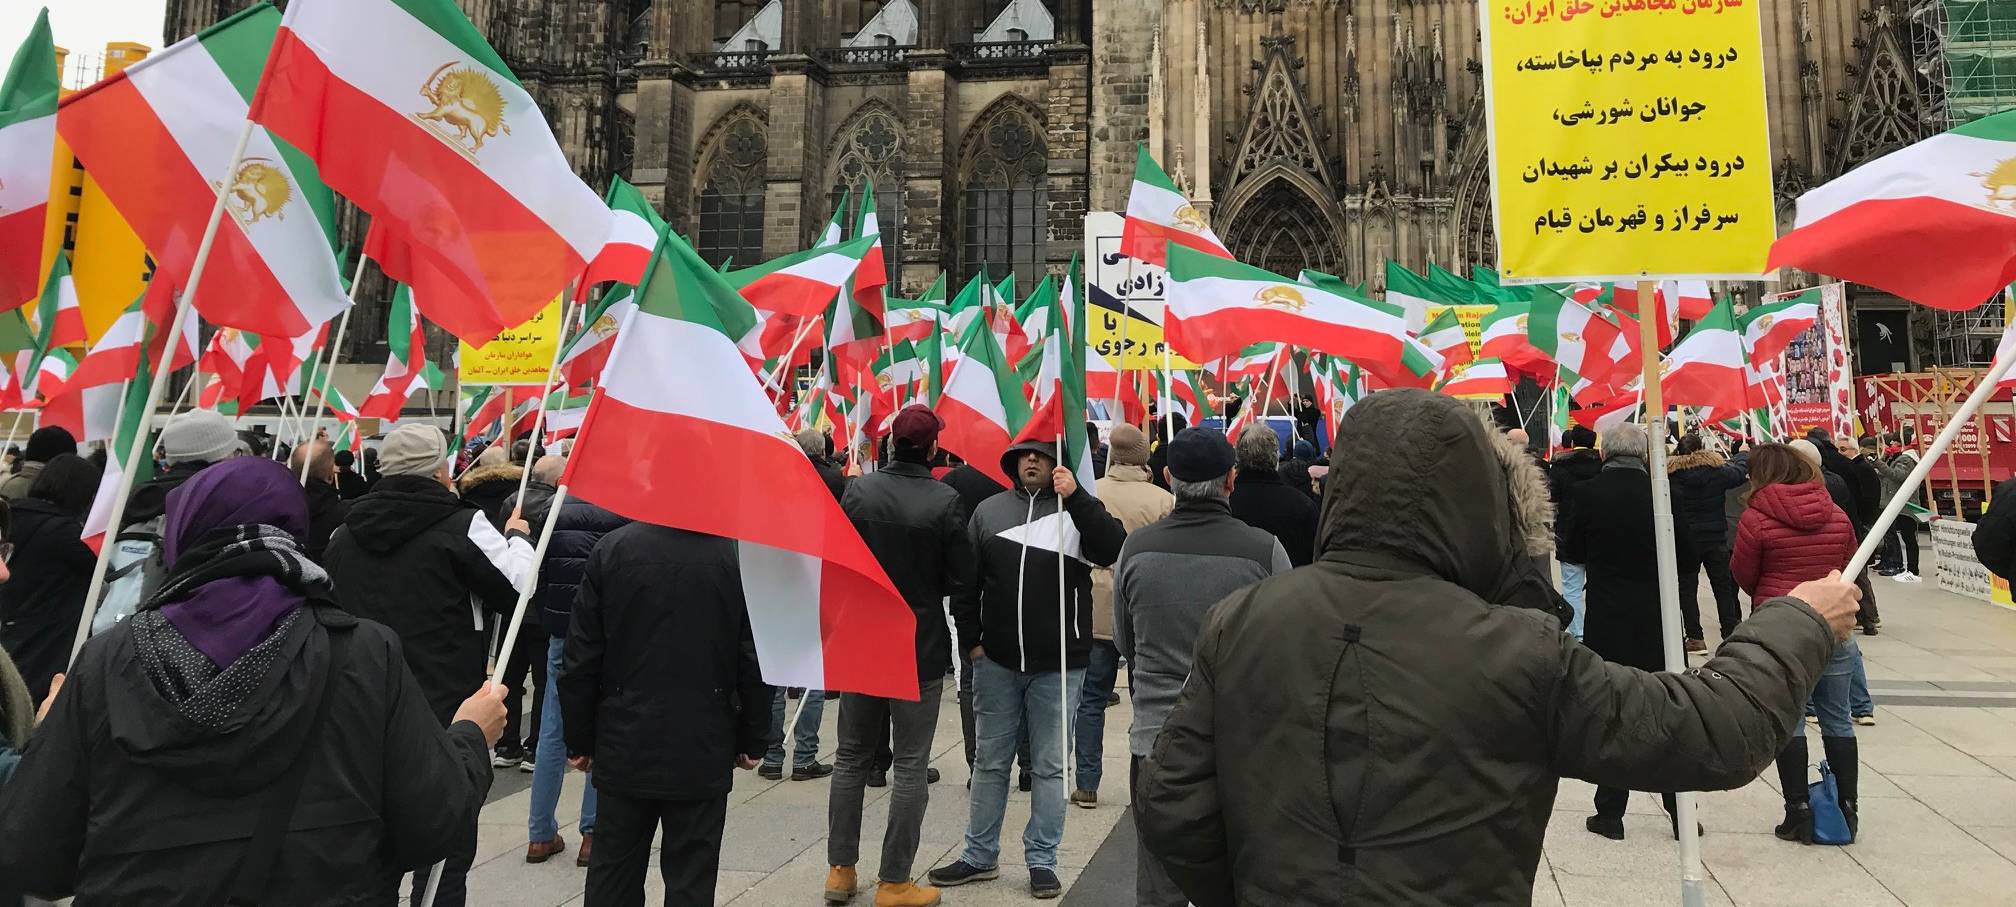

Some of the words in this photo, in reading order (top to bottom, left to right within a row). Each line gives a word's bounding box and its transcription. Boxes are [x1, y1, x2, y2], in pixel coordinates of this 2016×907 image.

[1516, 48, 1603, 75] بپاخاسته،
[1609, 50, 1659, 73] مردم
[1664, 49, 1683, 69] به
[1688, 47, 1738, 70] درود
[1552, 98, 1634, 127] شورشی،
[1639, 96, 1707, 123] جوانان
[1522, 156, 1593, 184] شهیدان
[1599, 159, 1618, 181] بر
[1624, 152, 1689, 179] بیکران
[1695, 155, 1745, 178] درود
[1534, 207, 1572, 236] قیام
[1578, 204, 1647, 234] قهرمان
[1653, 213, 1665, 232] و
[1670, 203, 1739, 232] سرفراز
[1103, 312, 1117, 336] با
[502, 332, 515, 344] دنیا
[519, 332, 542, 344] سراسر
[1095, 337, 1147, 356] رجوی
[484, 351, 506, 361] سازمان
[467, 365, 484, 376] آلمان
[492, 366, 509, 375] ایران
[510, 367, 521, 375] خلق
[522, 366, 549, 375] مجاهدین
